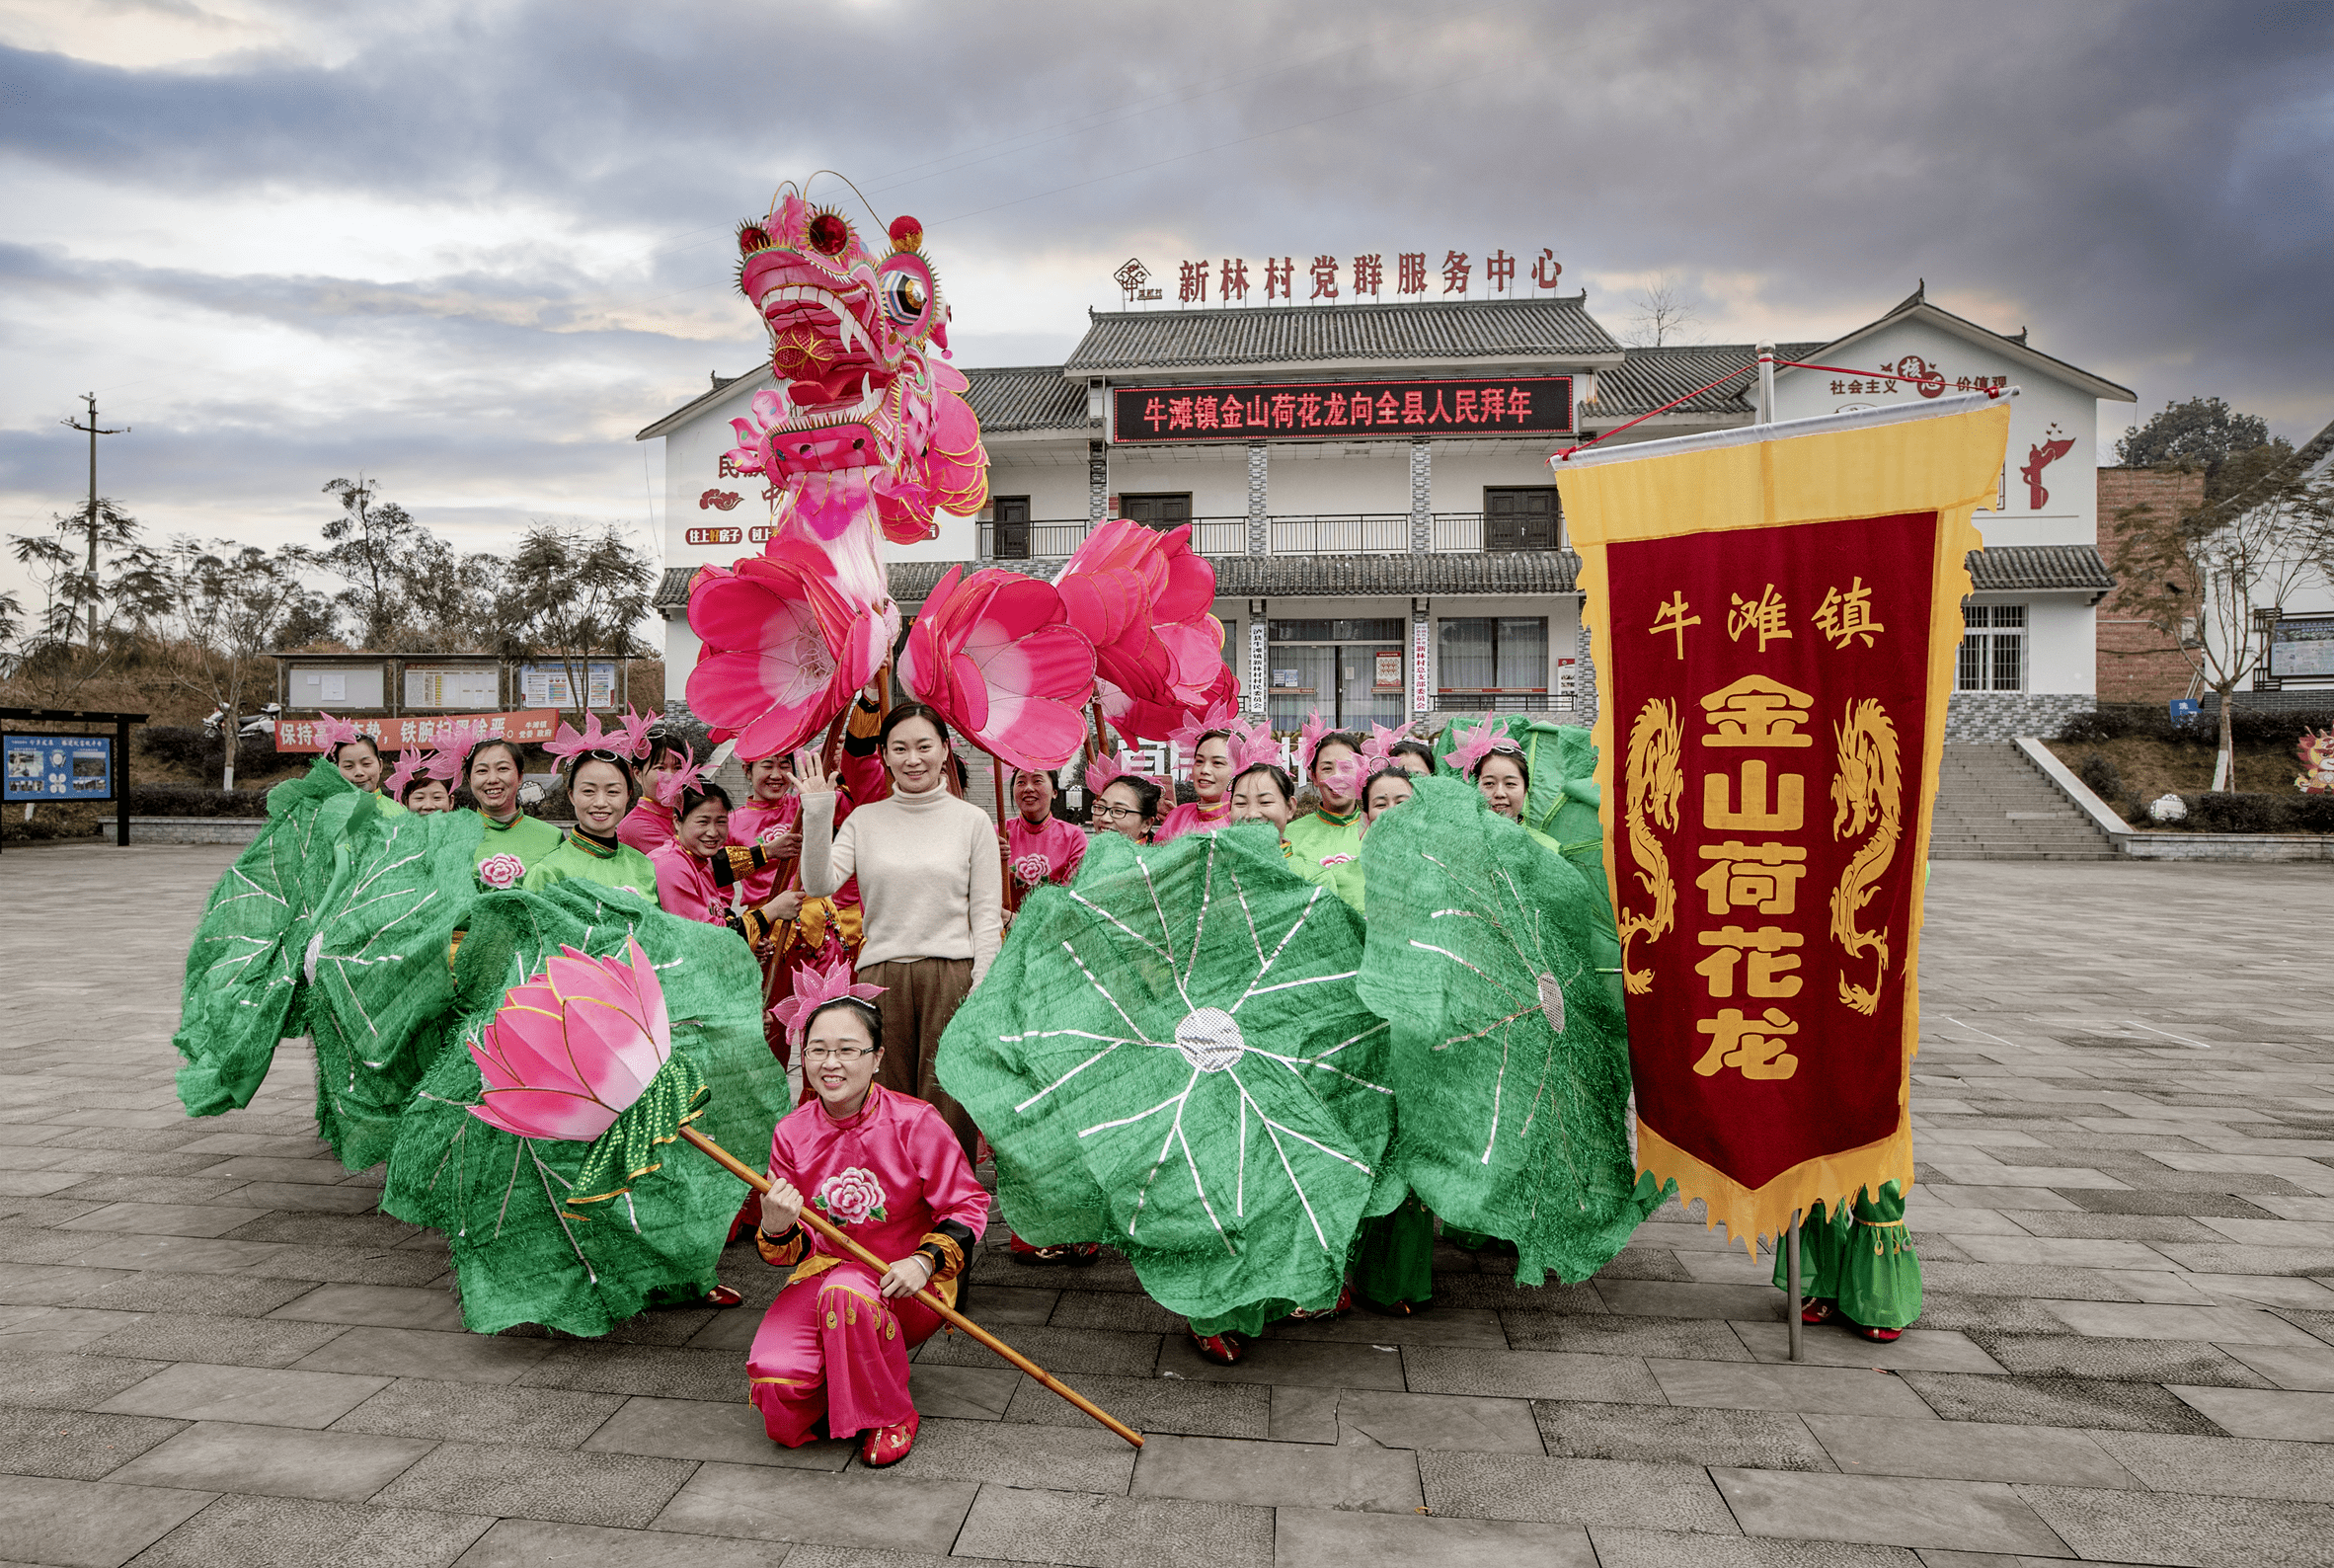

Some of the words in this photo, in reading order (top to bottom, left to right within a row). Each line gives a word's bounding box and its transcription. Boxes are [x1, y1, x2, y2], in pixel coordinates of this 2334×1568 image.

[1178, 248, 1562, 303] 新林村党群服务中心
[1143, 386, 1532, 432] 牛滩镇金山荷花龙向全县人民拜年
[1829, 379, 1898, 395] 社会主义
[689, 528, 740, 543] 住上好房子
[1648, 576, 1885, 661] 牛滩镇
[1692, 673, 1815, 1081] 金山荷花龙
